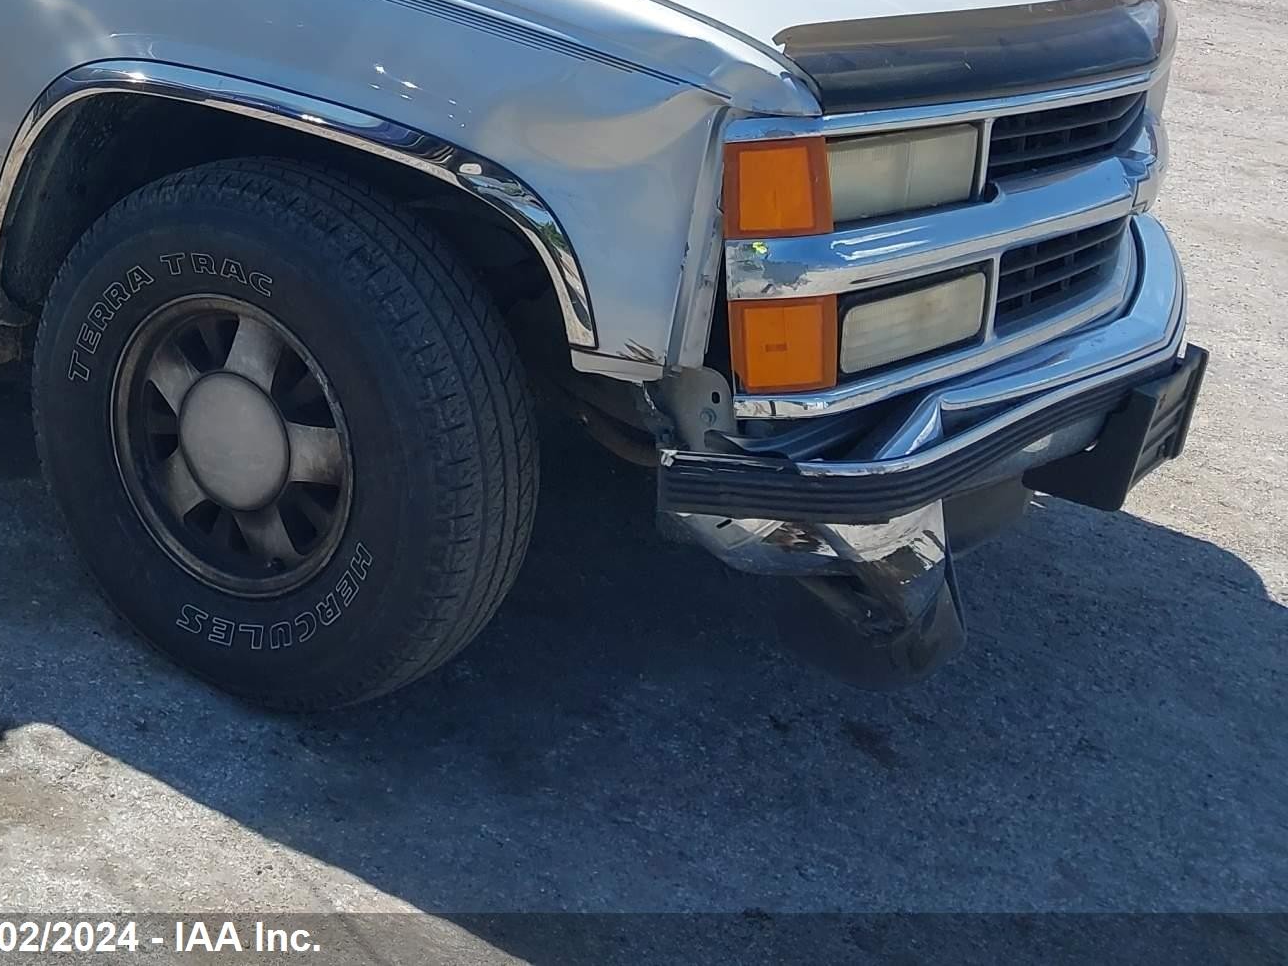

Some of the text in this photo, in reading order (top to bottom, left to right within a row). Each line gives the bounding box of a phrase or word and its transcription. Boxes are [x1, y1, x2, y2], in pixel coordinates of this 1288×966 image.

[68, 252, 274, 382] TERRA TRAC
[176, 542, 373, 649] HERCULES
